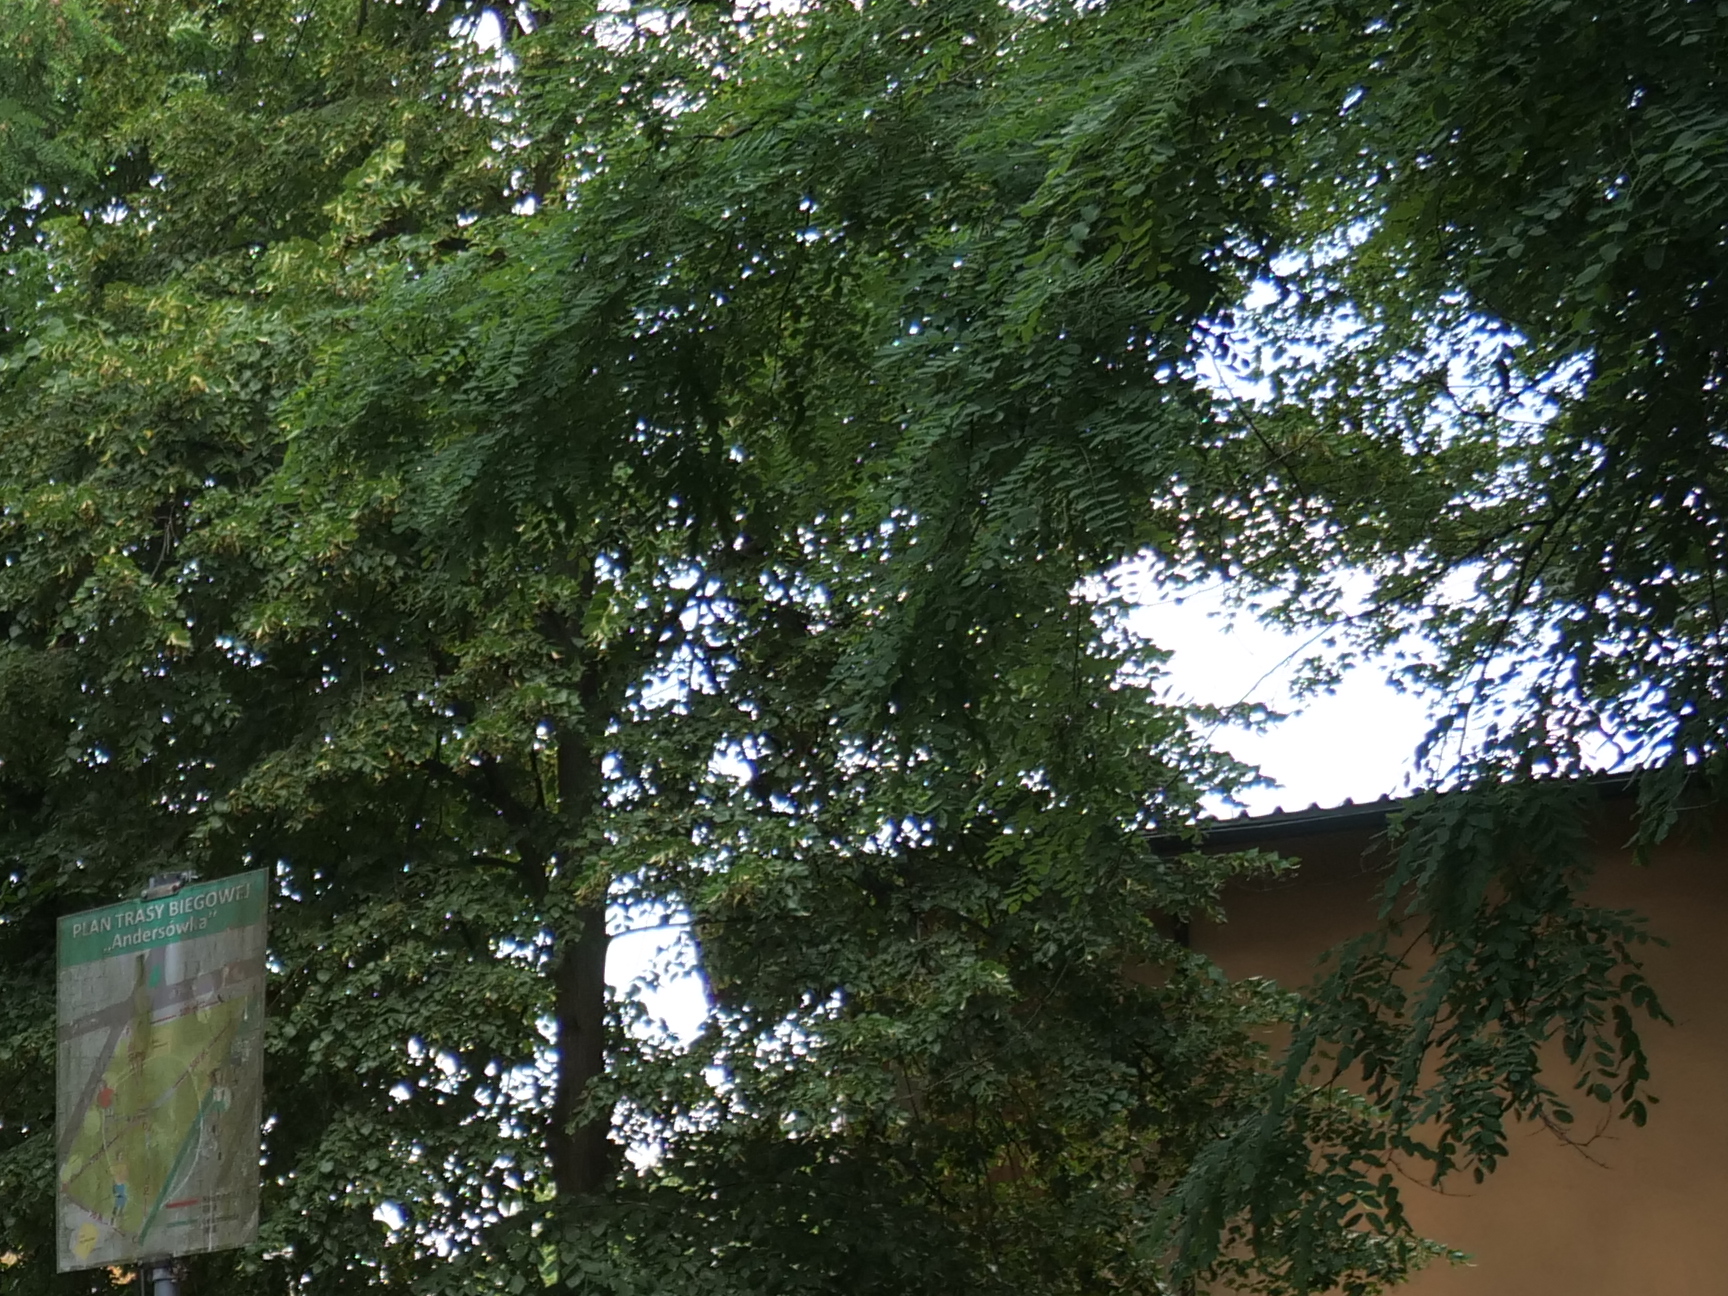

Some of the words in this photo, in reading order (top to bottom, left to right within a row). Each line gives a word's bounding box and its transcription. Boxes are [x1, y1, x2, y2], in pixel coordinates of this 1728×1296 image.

[73, 917, 111, 938] PLAN
[115, 903, 165, 928] TRASY
[169, 884, 250, 917] BIEGOWEJ
